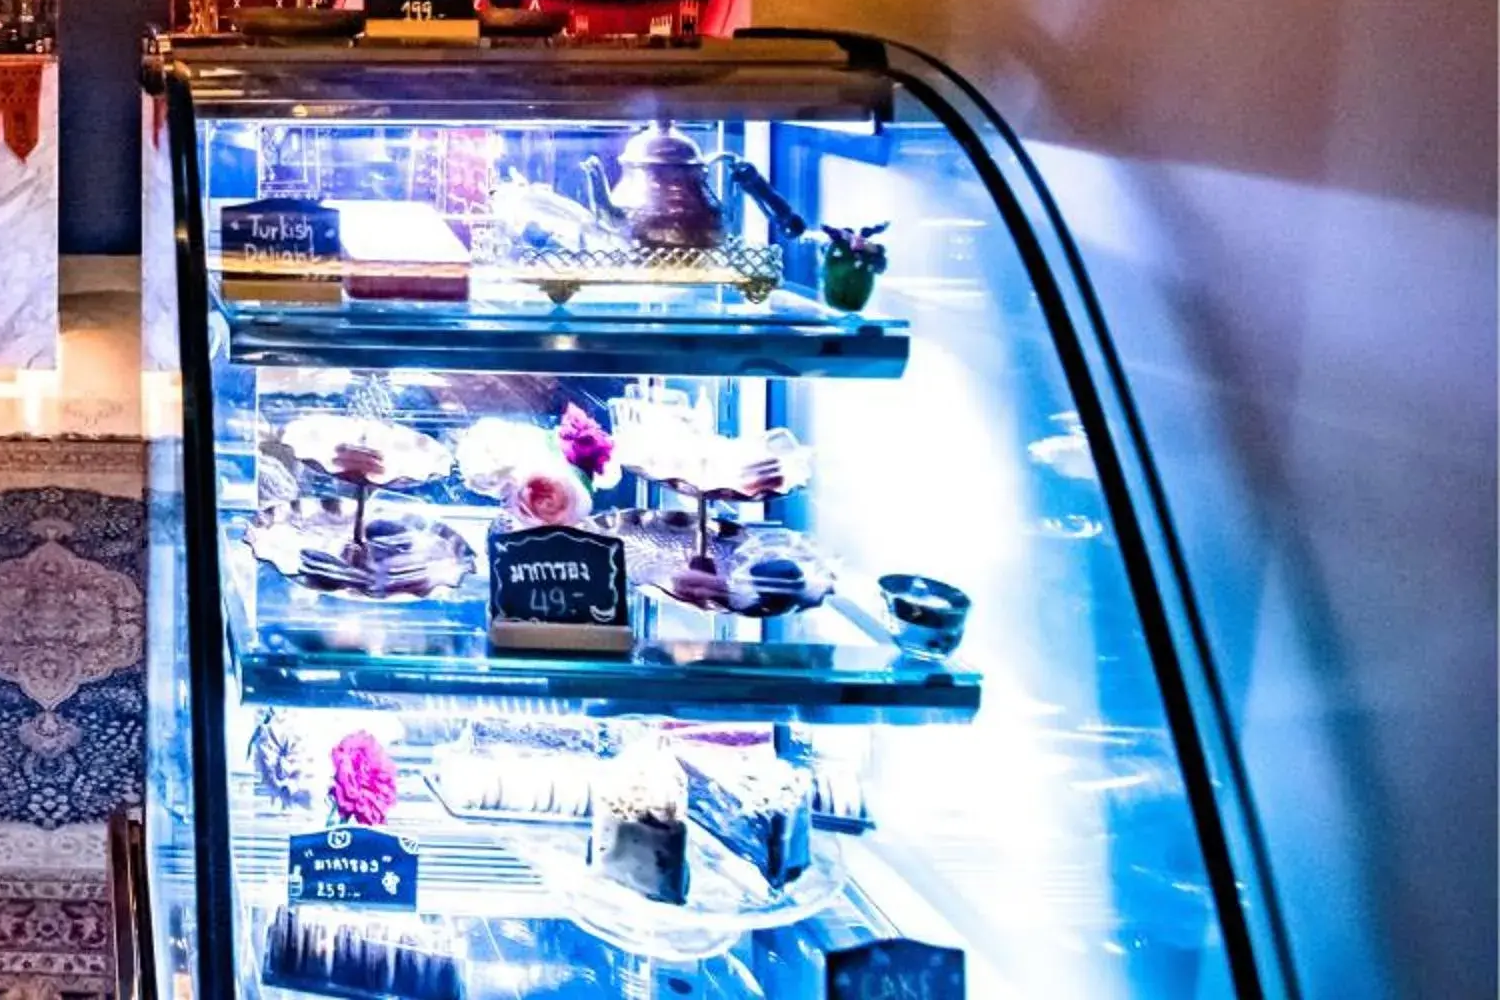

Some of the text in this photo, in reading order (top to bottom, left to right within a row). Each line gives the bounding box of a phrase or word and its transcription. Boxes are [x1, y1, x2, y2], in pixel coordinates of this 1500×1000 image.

[247, 214, 314, 241] Turkish
[510, 560, 590, 583] มาการอง
